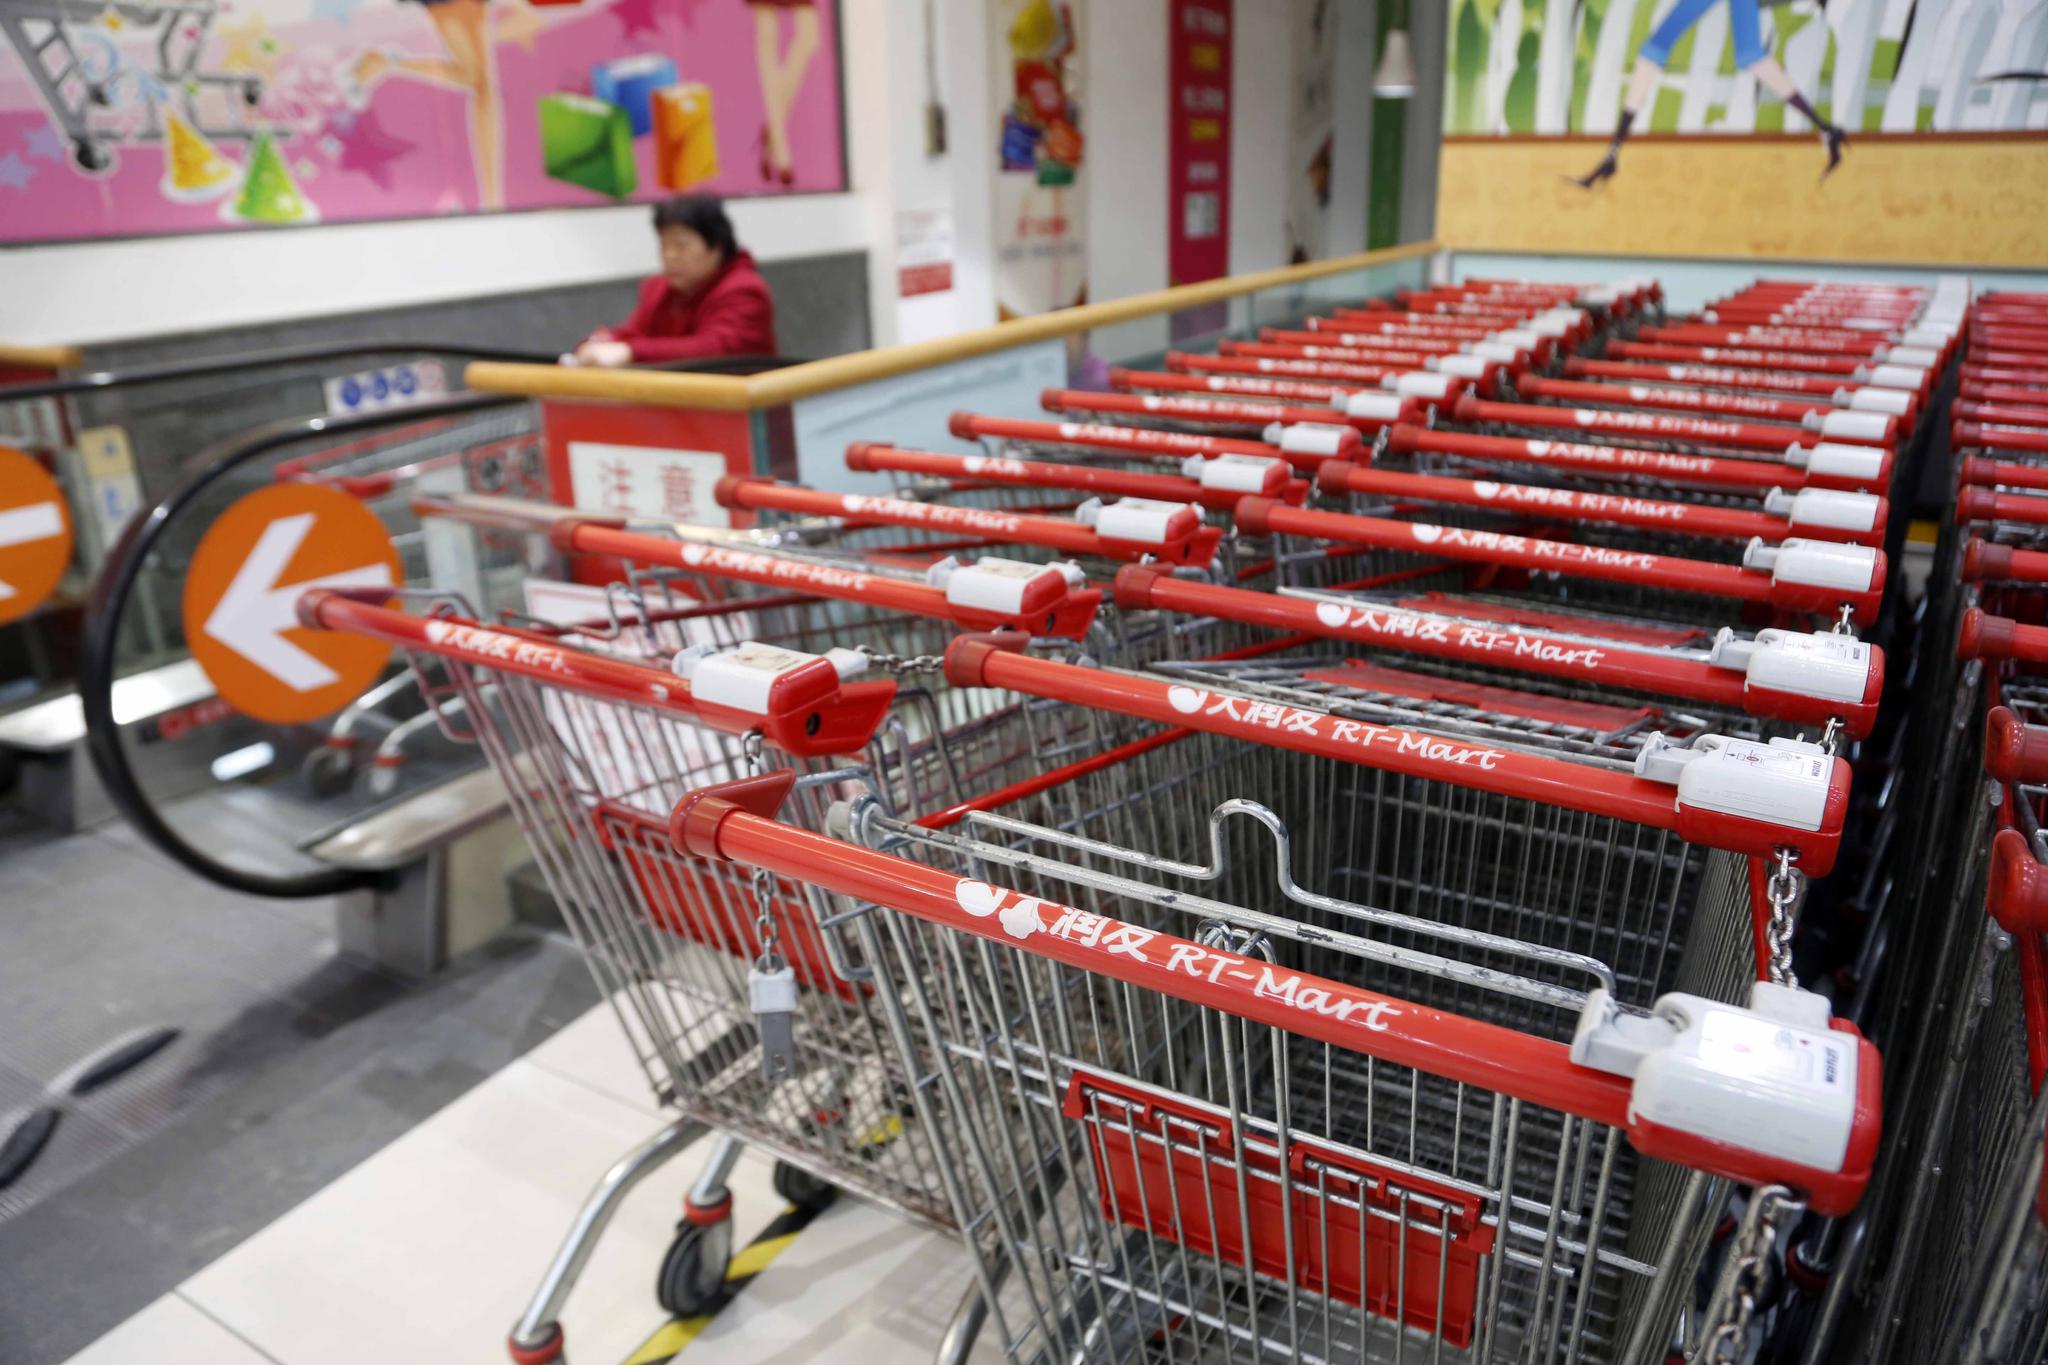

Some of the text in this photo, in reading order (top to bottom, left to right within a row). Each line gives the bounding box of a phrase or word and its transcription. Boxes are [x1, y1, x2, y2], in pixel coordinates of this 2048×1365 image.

[1579, 494, 1687, 520] RT-Mart
[1534, 539, 1657, 569] RT-Mart
[1458, 627, 1604, 667] RT-Mart
[1331, 720, 1505, 770] RT-Mart
[1166, 943, 1403, 1032] RT-Mart
